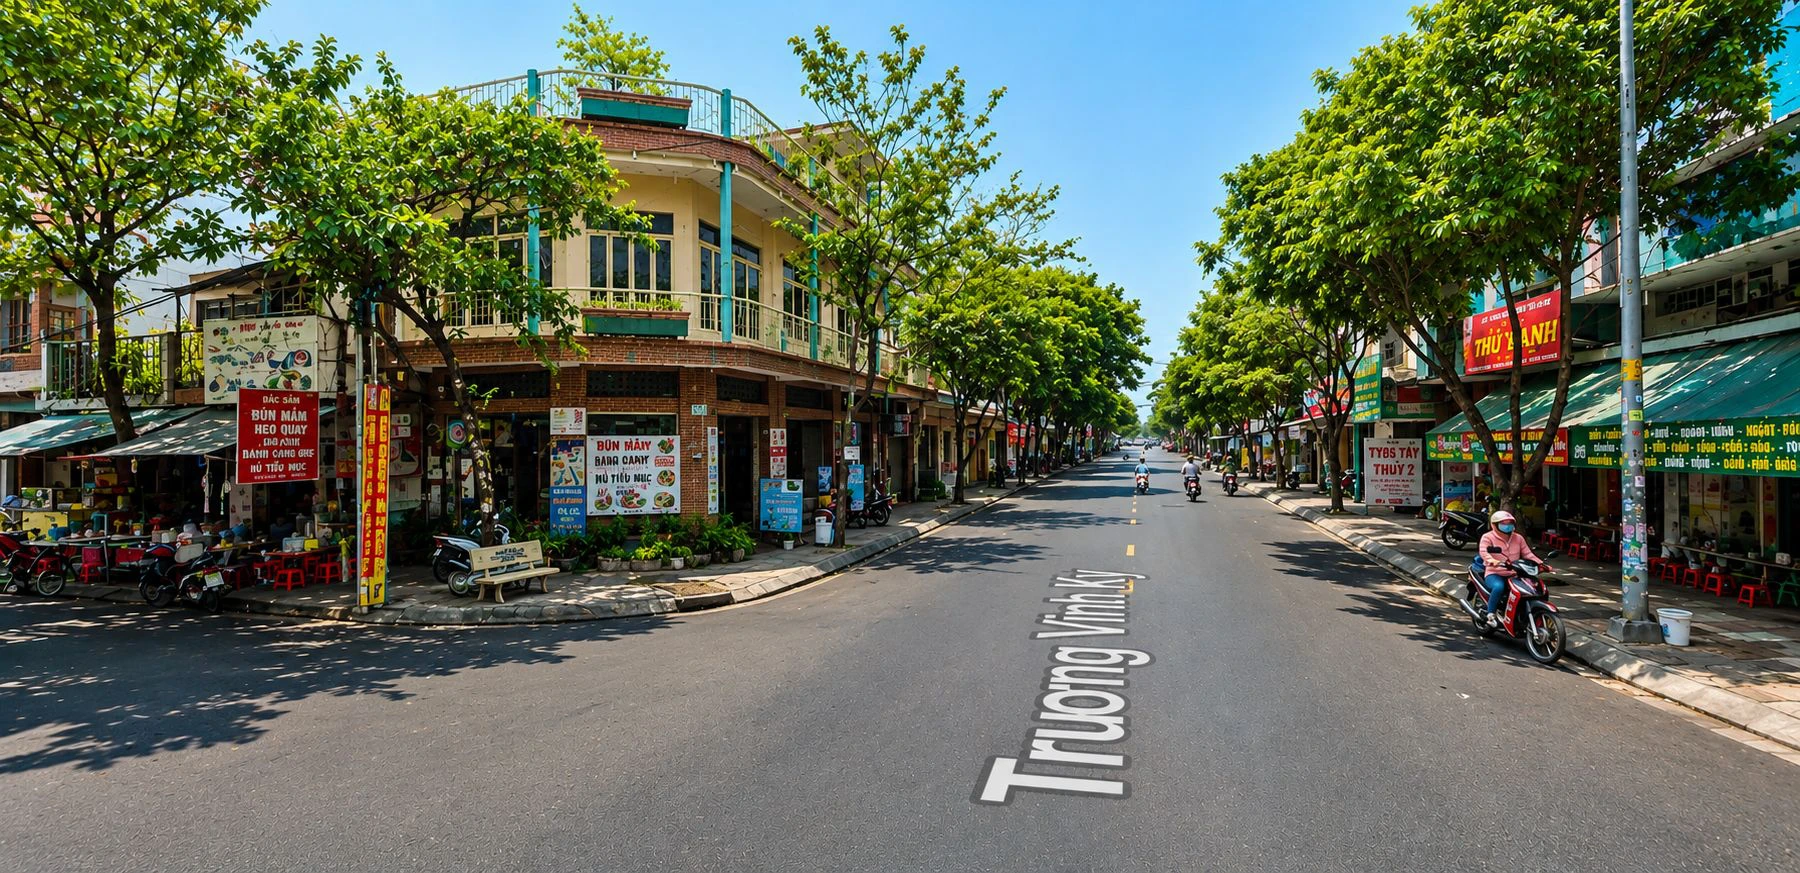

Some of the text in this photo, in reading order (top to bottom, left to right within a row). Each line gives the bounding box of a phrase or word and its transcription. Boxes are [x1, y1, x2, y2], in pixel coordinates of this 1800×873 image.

[254, 424, 308, 436] HEO QUAY
[1407, 463, 1415, 476] 2
